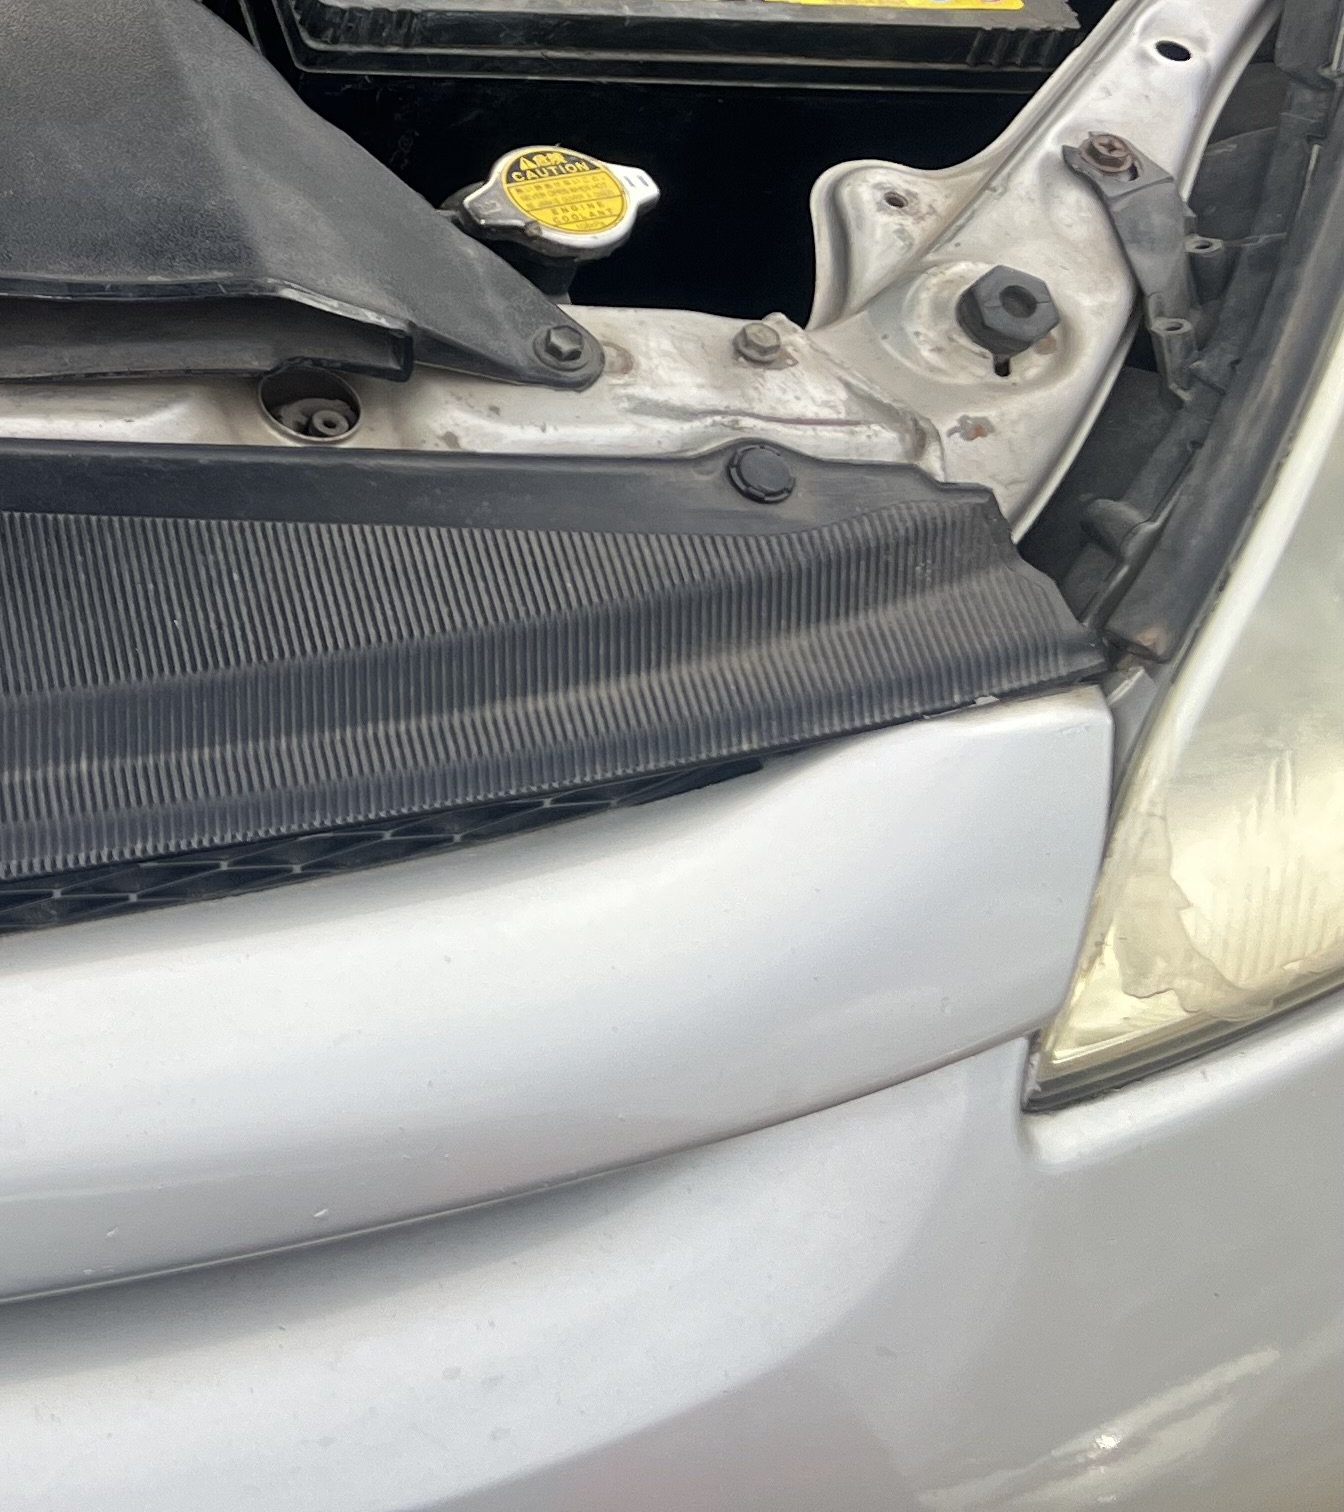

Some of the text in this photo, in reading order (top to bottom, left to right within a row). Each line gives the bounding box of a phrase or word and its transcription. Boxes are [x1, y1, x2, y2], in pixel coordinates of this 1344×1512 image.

[511, 161, 590, 182] CAUTION
[551, 201, 606, 216] ENGINE
[553, 208, 615, 224] COOLANT
